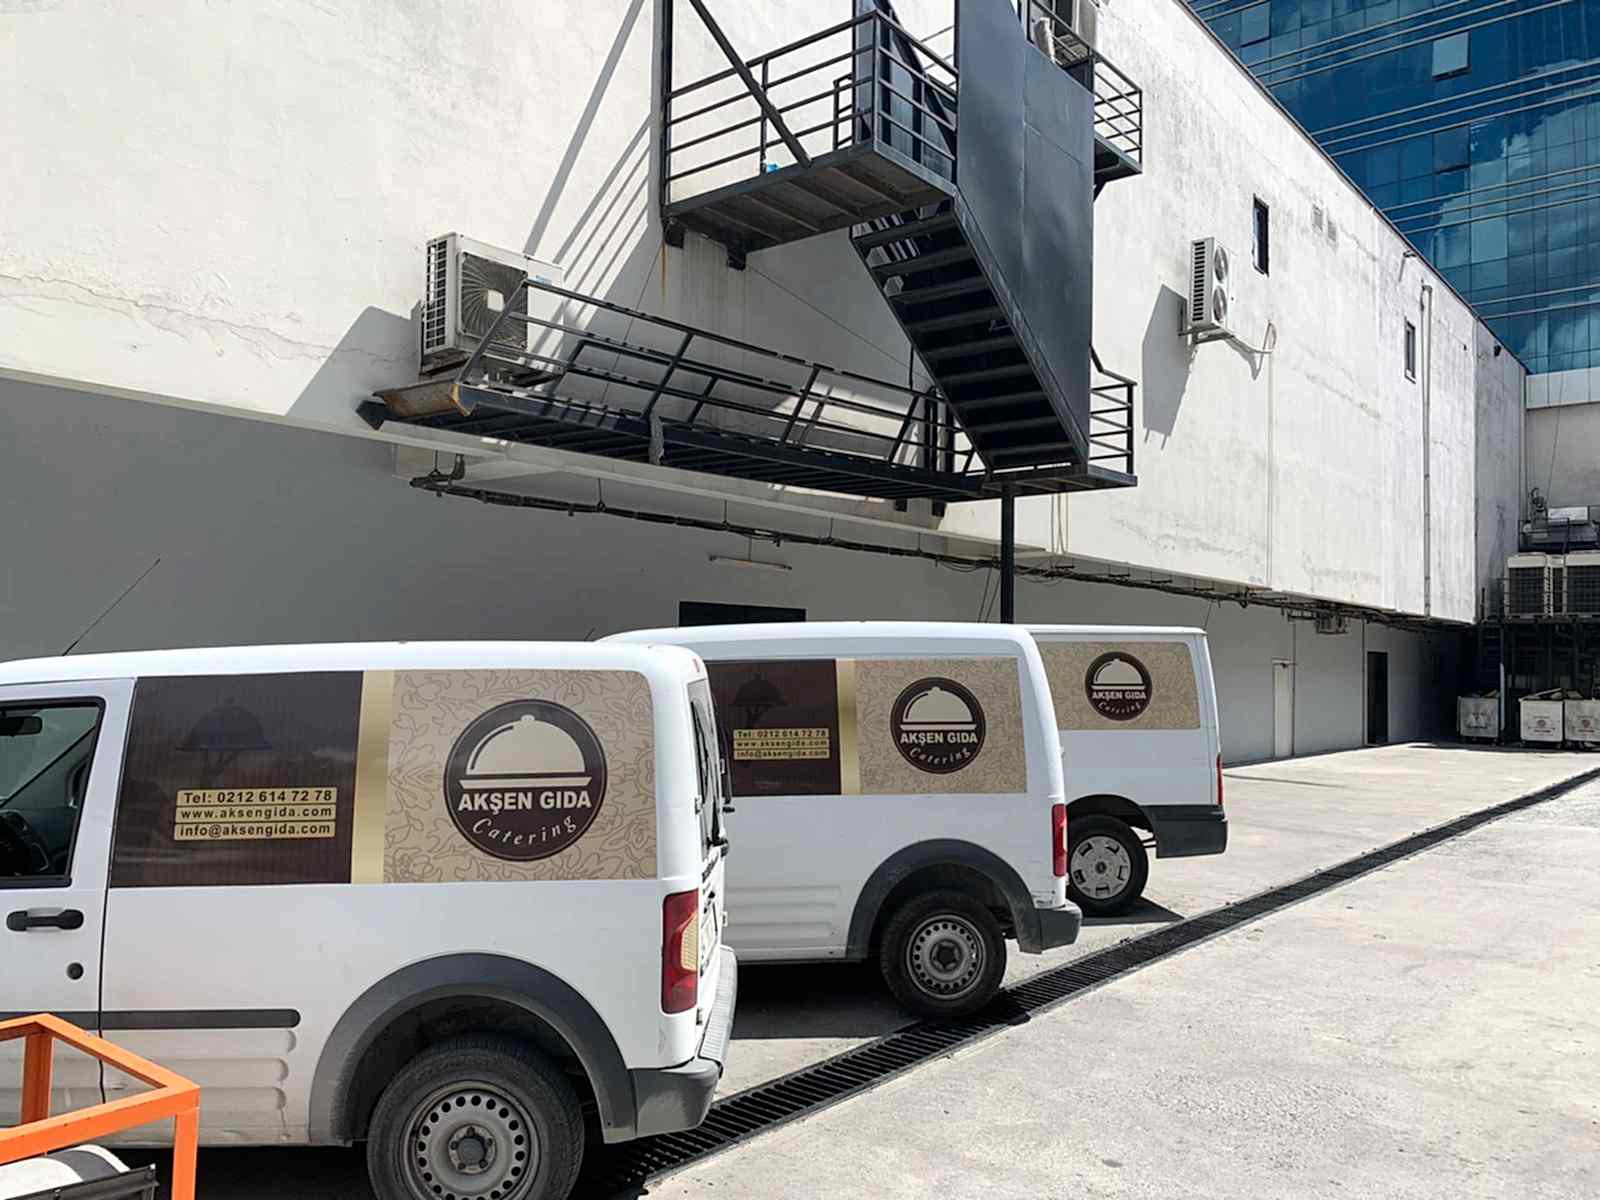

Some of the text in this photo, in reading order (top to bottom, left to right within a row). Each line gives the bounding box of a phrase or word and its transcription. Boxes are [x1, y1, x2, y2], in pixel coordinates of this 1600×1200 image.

[900, 732, 978, 746] AKŞEN GIDA
[184, 790, 332, 803] Tel: 0212 614 72 78
[458, 791, 592, 815] AKŞEN GIDA
[181, 807, 332, 819] www.aksengida.com
[180, 823, 331, 838] info@aksengida.com
[472, 815, 577, 845] Catering
